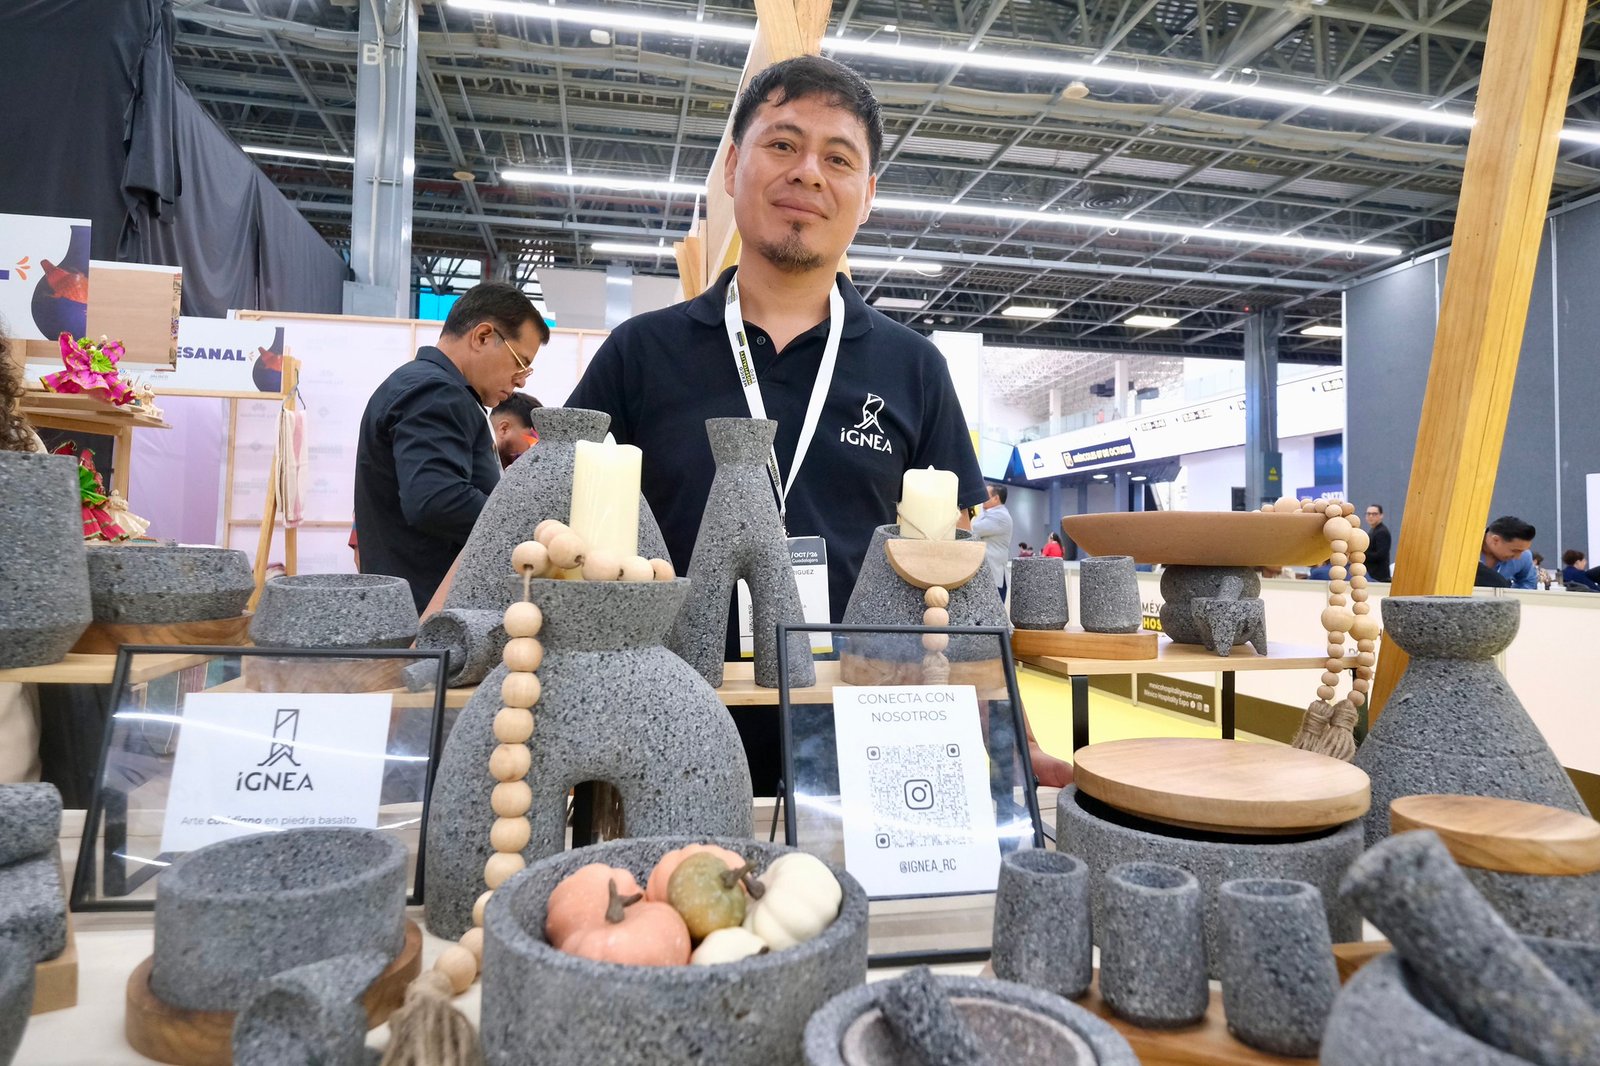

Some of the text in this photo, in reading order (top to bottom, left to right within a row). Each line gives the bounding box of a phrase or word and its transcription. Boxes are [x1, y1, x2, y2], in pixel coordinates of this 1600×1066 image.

[858, 692, 955, 704] CONECTA CON
[871, 710, 947, 722] NOSOTROS
[181, 816, 204, 825] Arte
[281, 815, 316, 826] piedra
[318, 815, 357, 824] basalto
[899, 858, 957, 873] @IGNEA_RC
